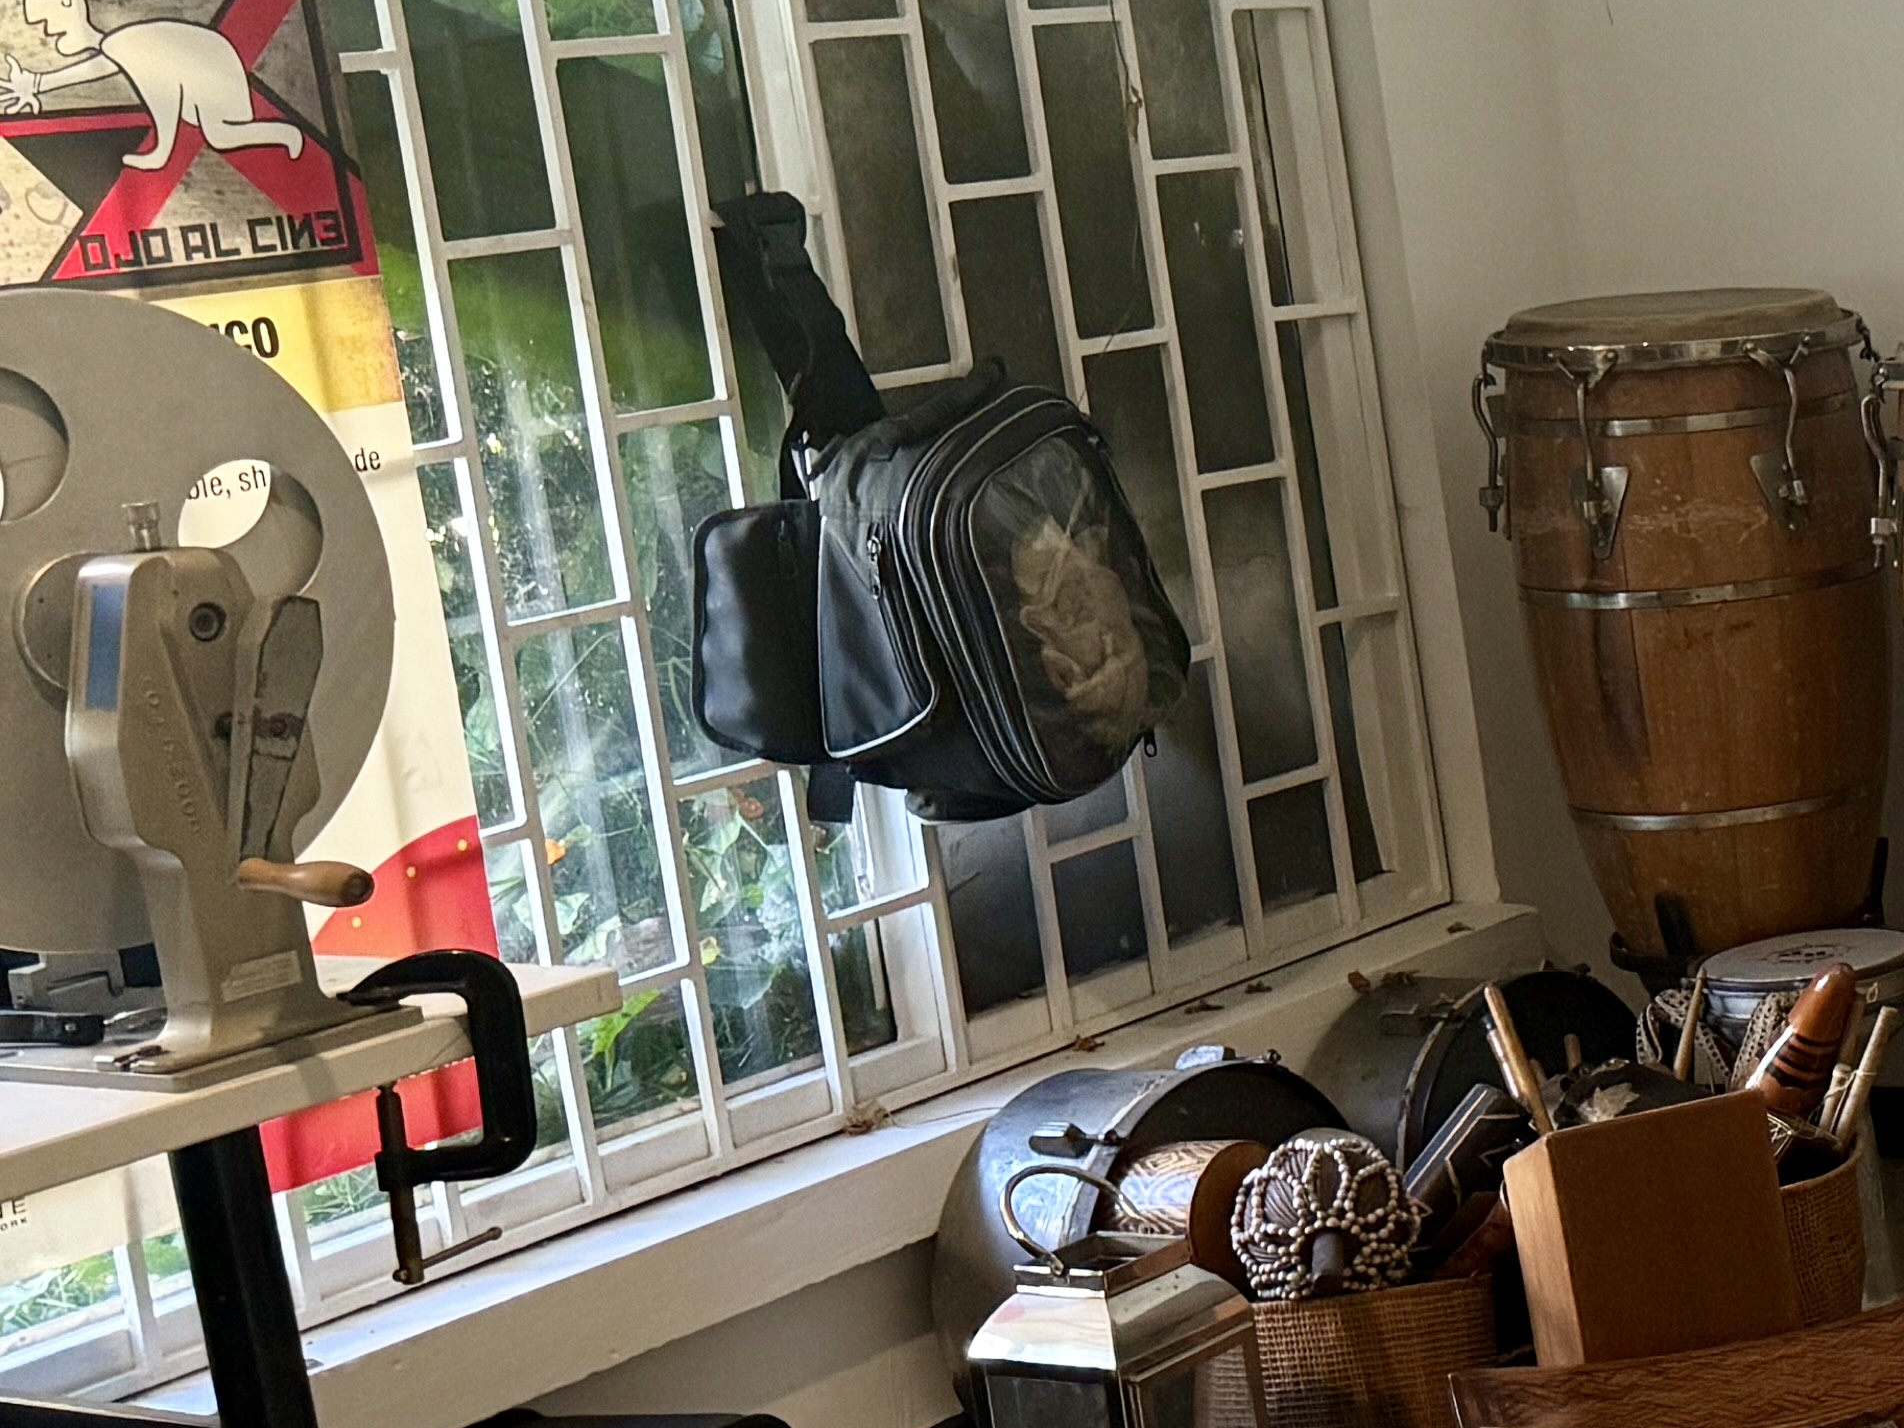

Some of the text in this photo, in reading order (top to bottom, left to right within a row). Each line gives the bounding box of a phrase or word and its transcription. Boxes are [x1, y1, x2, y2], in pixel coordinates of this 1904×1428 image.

[79, 227, 173, 272] OJO
[180, 222, 241, 262] AL
[209, 316, 280, 359] CO
[354, 447, 381, 472] de
